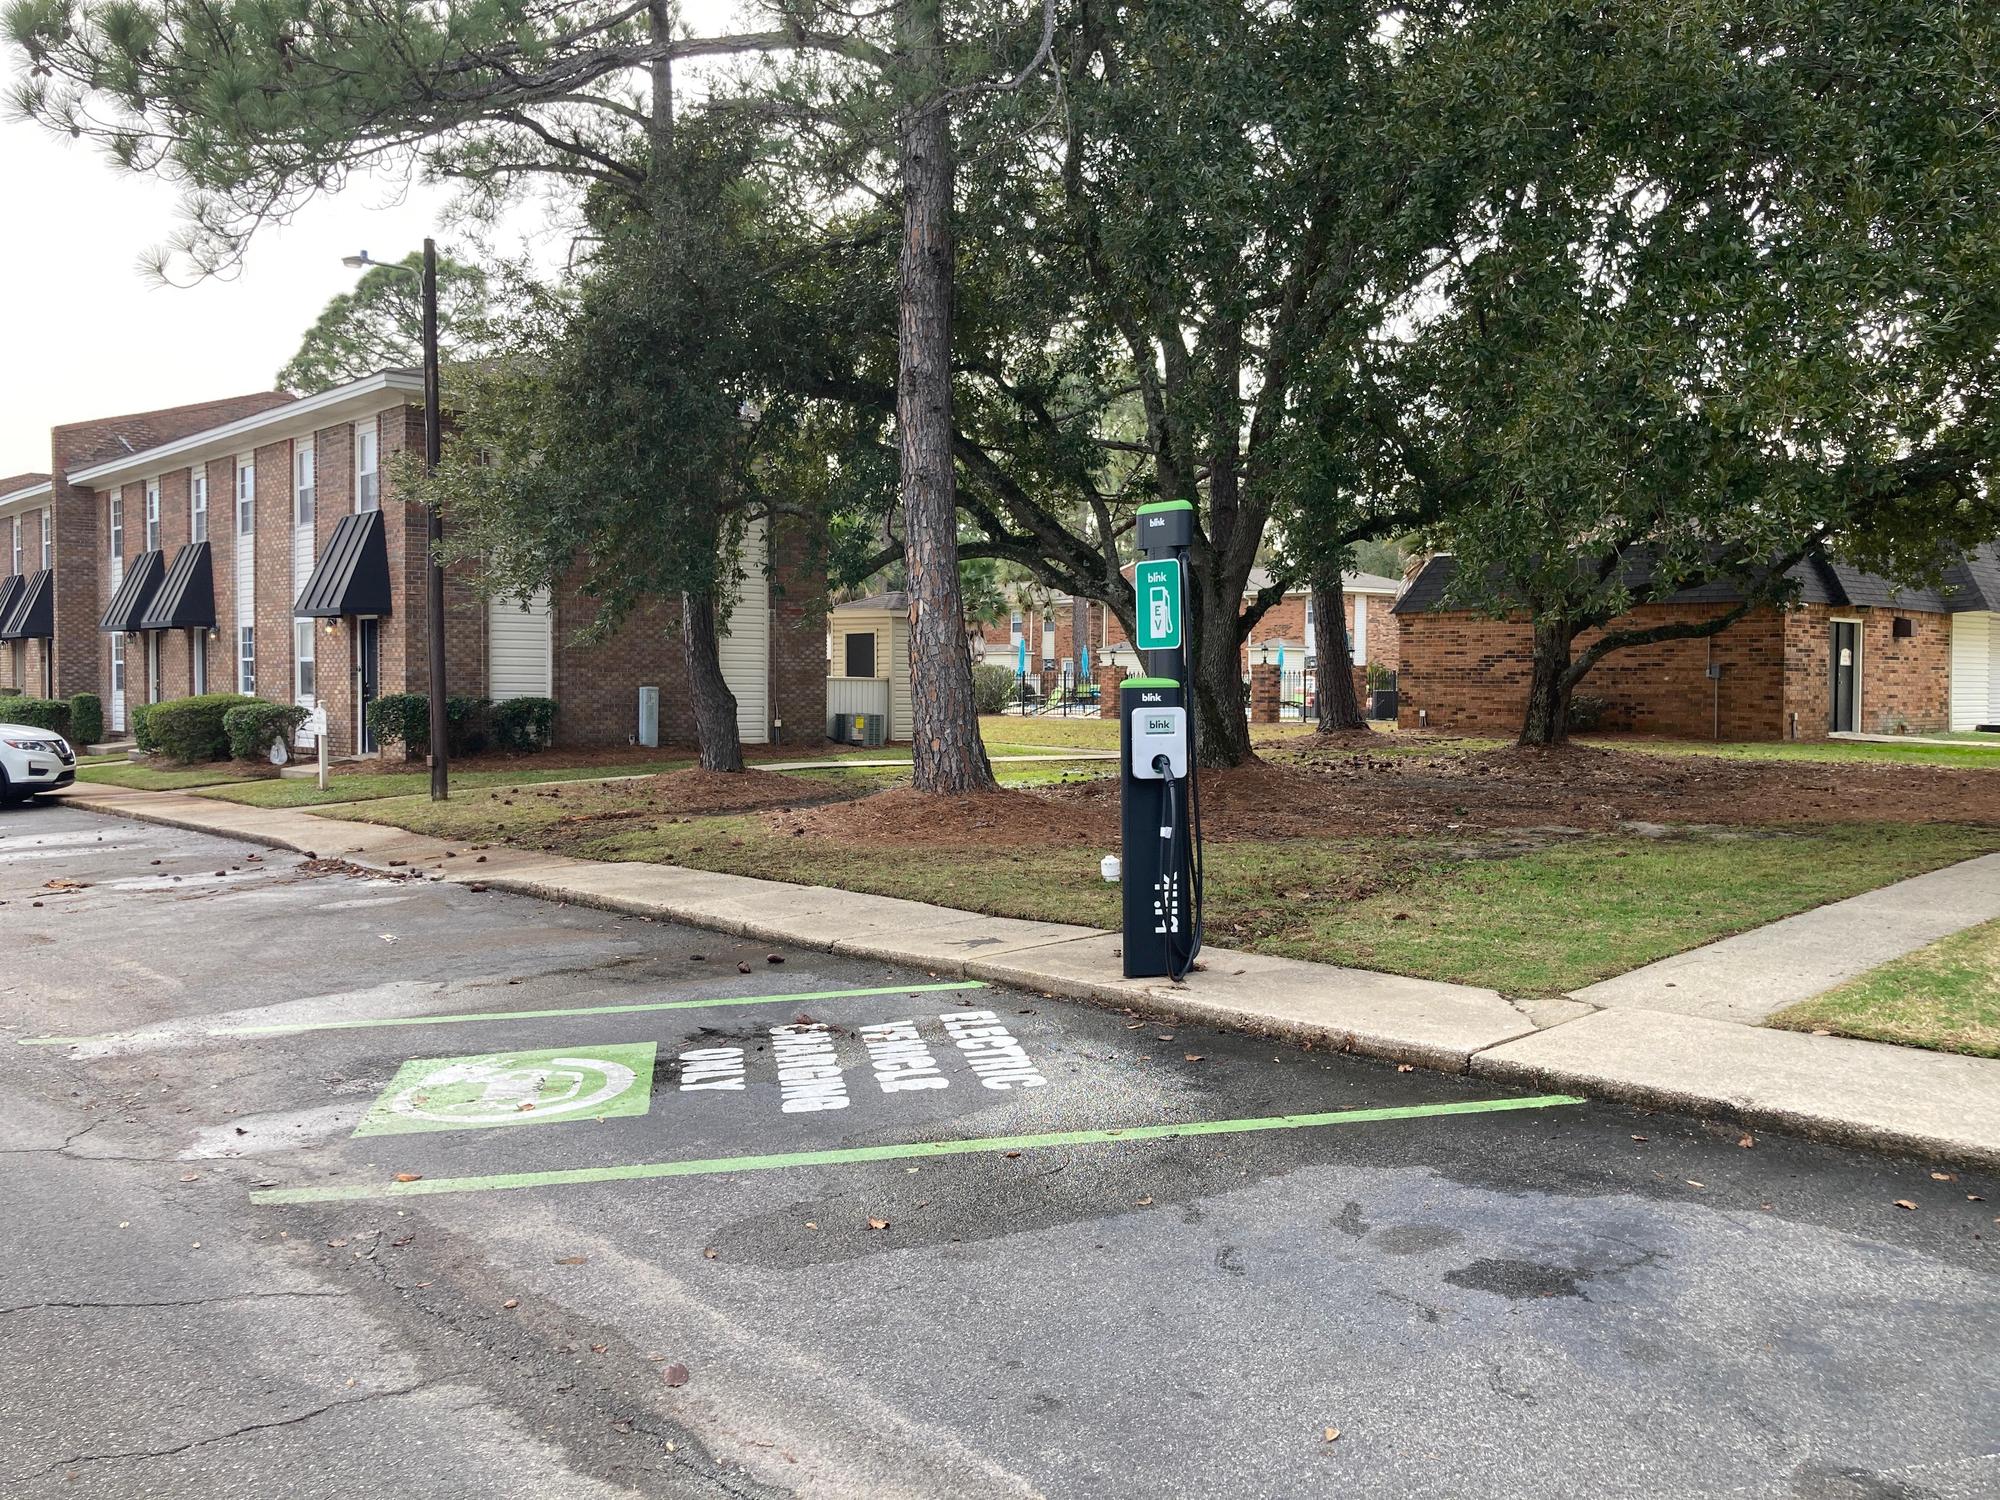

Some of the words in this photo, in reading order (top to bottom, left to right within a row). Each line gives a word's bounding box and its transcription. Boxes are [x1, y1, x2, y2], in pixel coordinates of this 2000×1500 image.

[1149, 517, 1166, 528] blink
[1147, 571, 1167, 583] blink
[1141, 692, 1162, 702] blink
[1149, 720, 1170, 729] blink
[859, 1020, 950, 1094] VEHICLE
[938, 1010, 1048, 1091] ELECTRIC
[678, 1047, 745, 1092] ONLY
[768, 1023, 850, 1113] CHARGING
